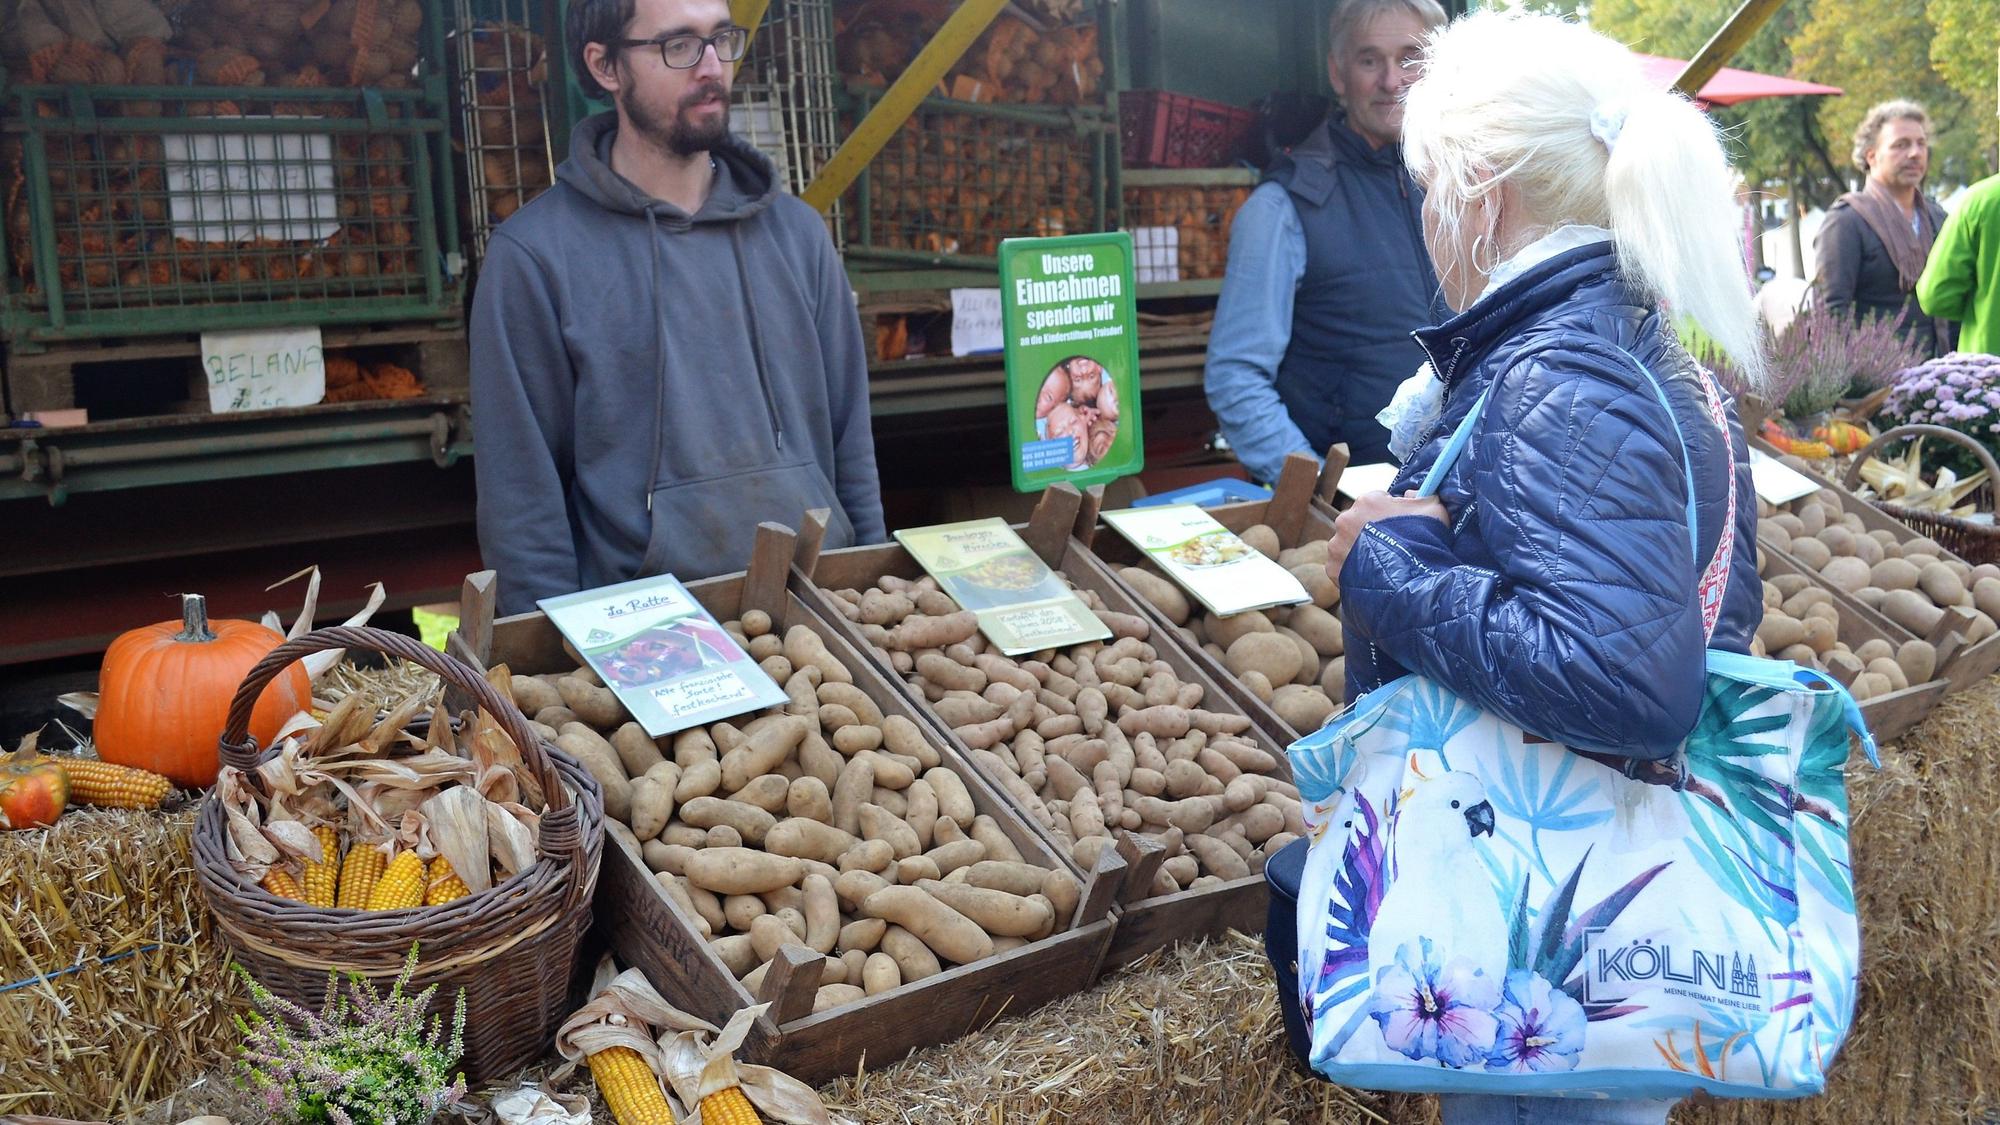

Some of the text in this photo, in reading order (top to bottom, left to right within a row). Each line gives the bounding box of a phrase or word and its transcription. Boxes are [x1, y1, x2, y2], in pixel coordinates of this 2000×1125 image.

[1042, 253, 1094, 275] Unsere
[1016, 274, 1121, 305] Einnahmen
[1026, 304, 1091, 330] spenden
[1092, 300, 1115, 322] wir
[1020, 336, 1031, 346] an
[1030, 334, 1043, 345] die
[1043, 329, 1093, 344] Kinderstiftung
[207, 345, 322, 384] BELANA
[625, 595, 670, 612] Ratte
[1598, 937, 1726, 991] KÖLN
[1664, 987, 1761, 1012] MEINE HEIMAT MEINE LIEBE
